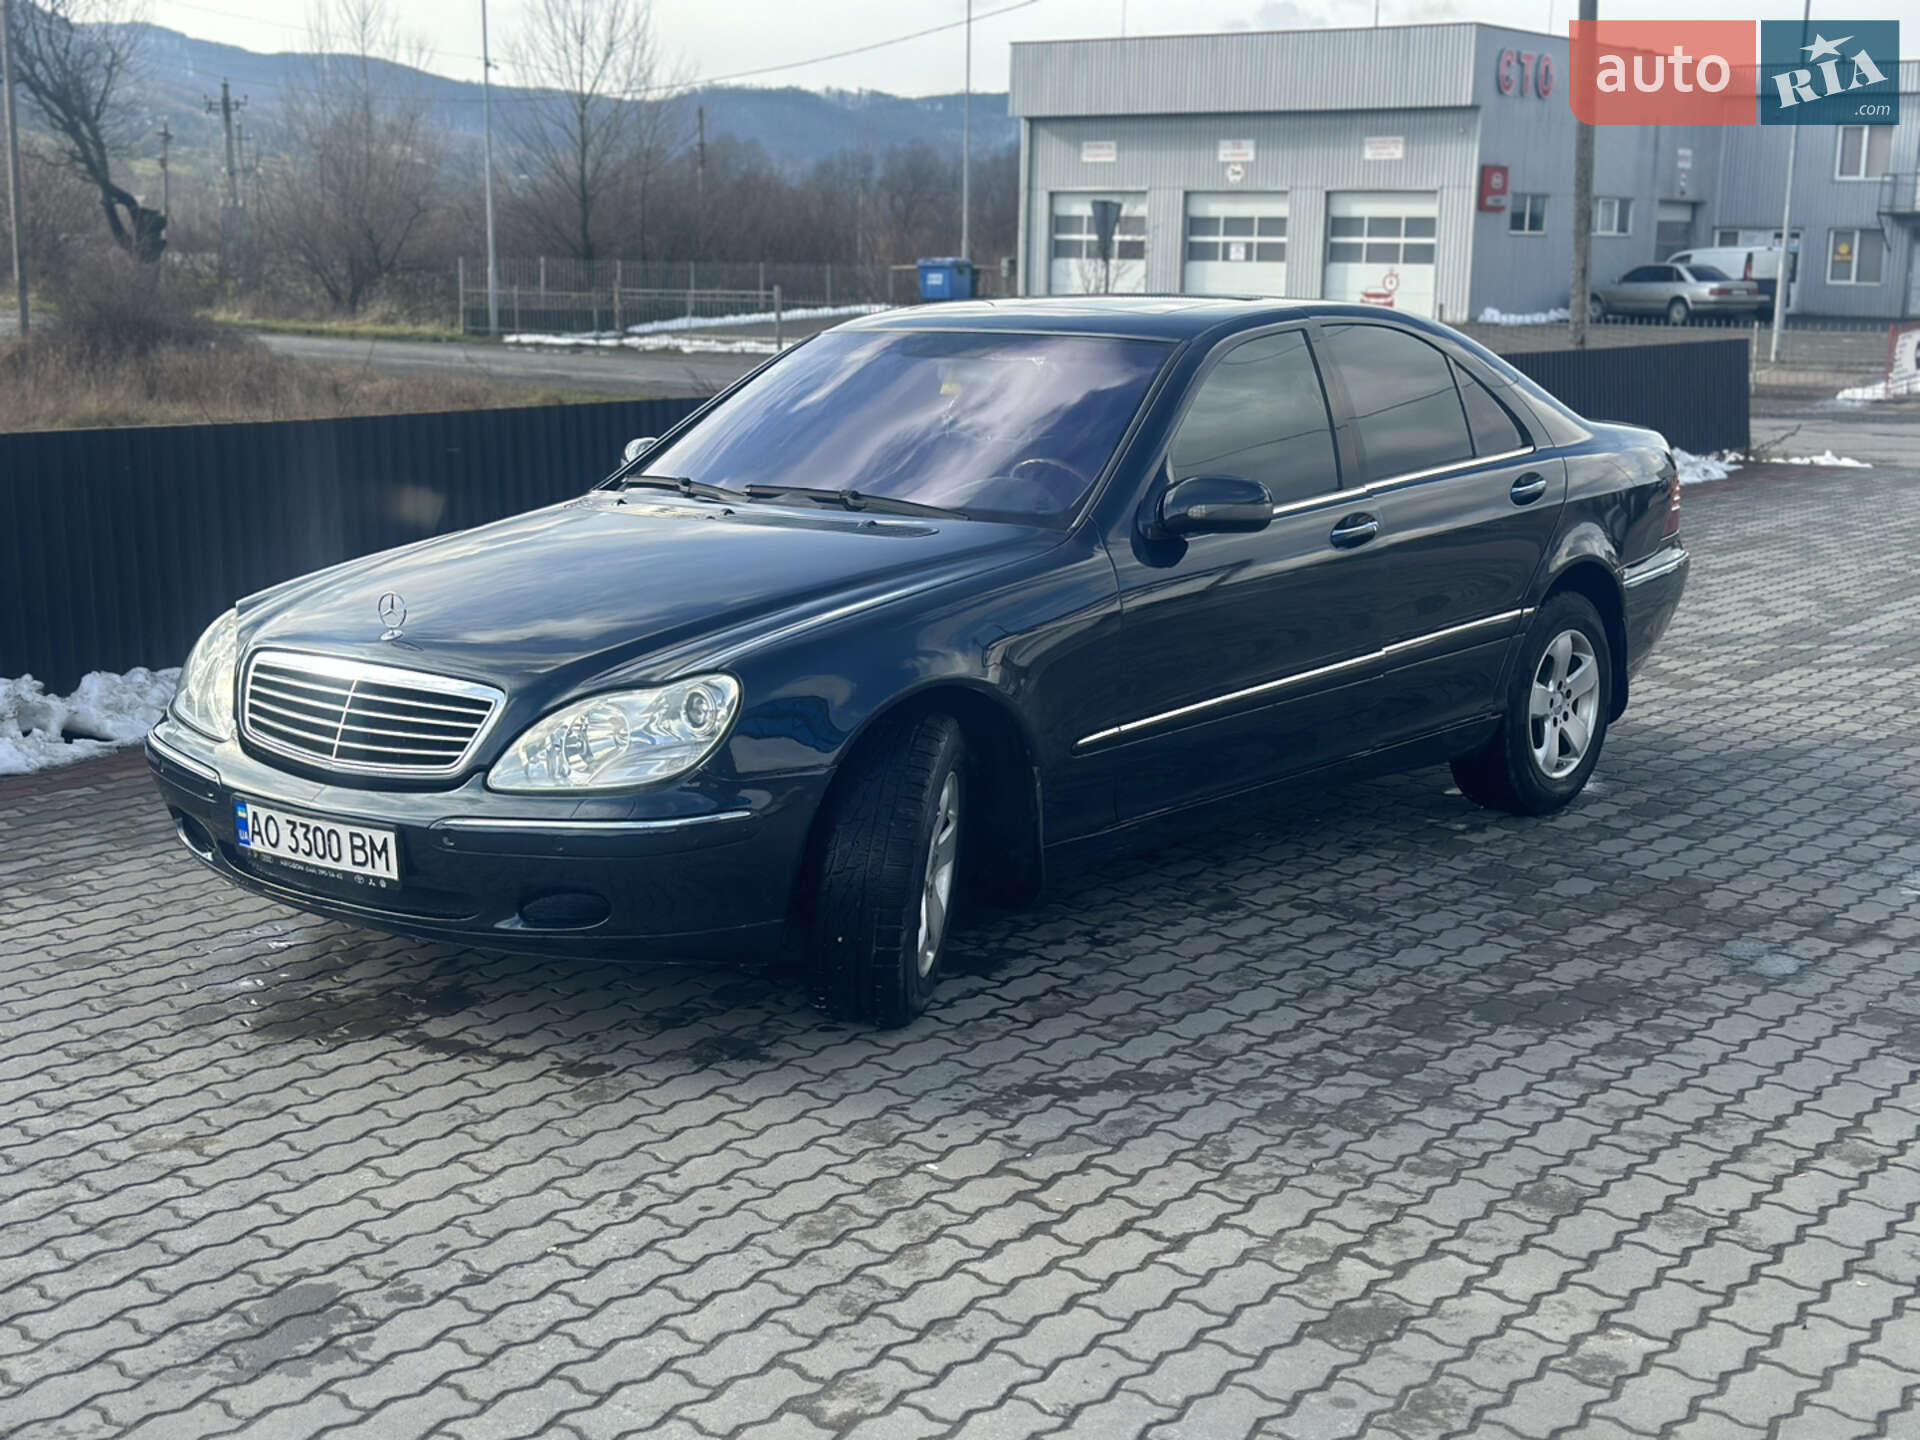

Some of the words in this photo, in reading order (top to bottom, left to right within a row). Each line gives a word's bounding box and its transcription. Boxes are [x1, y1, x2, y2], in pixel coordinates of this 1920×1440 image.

[239, 829, 249, 841] UA
[251, 811, 280, 849] AO
[286, 820, 342, 863] 3300
[349, 831, 390, 871] BM
